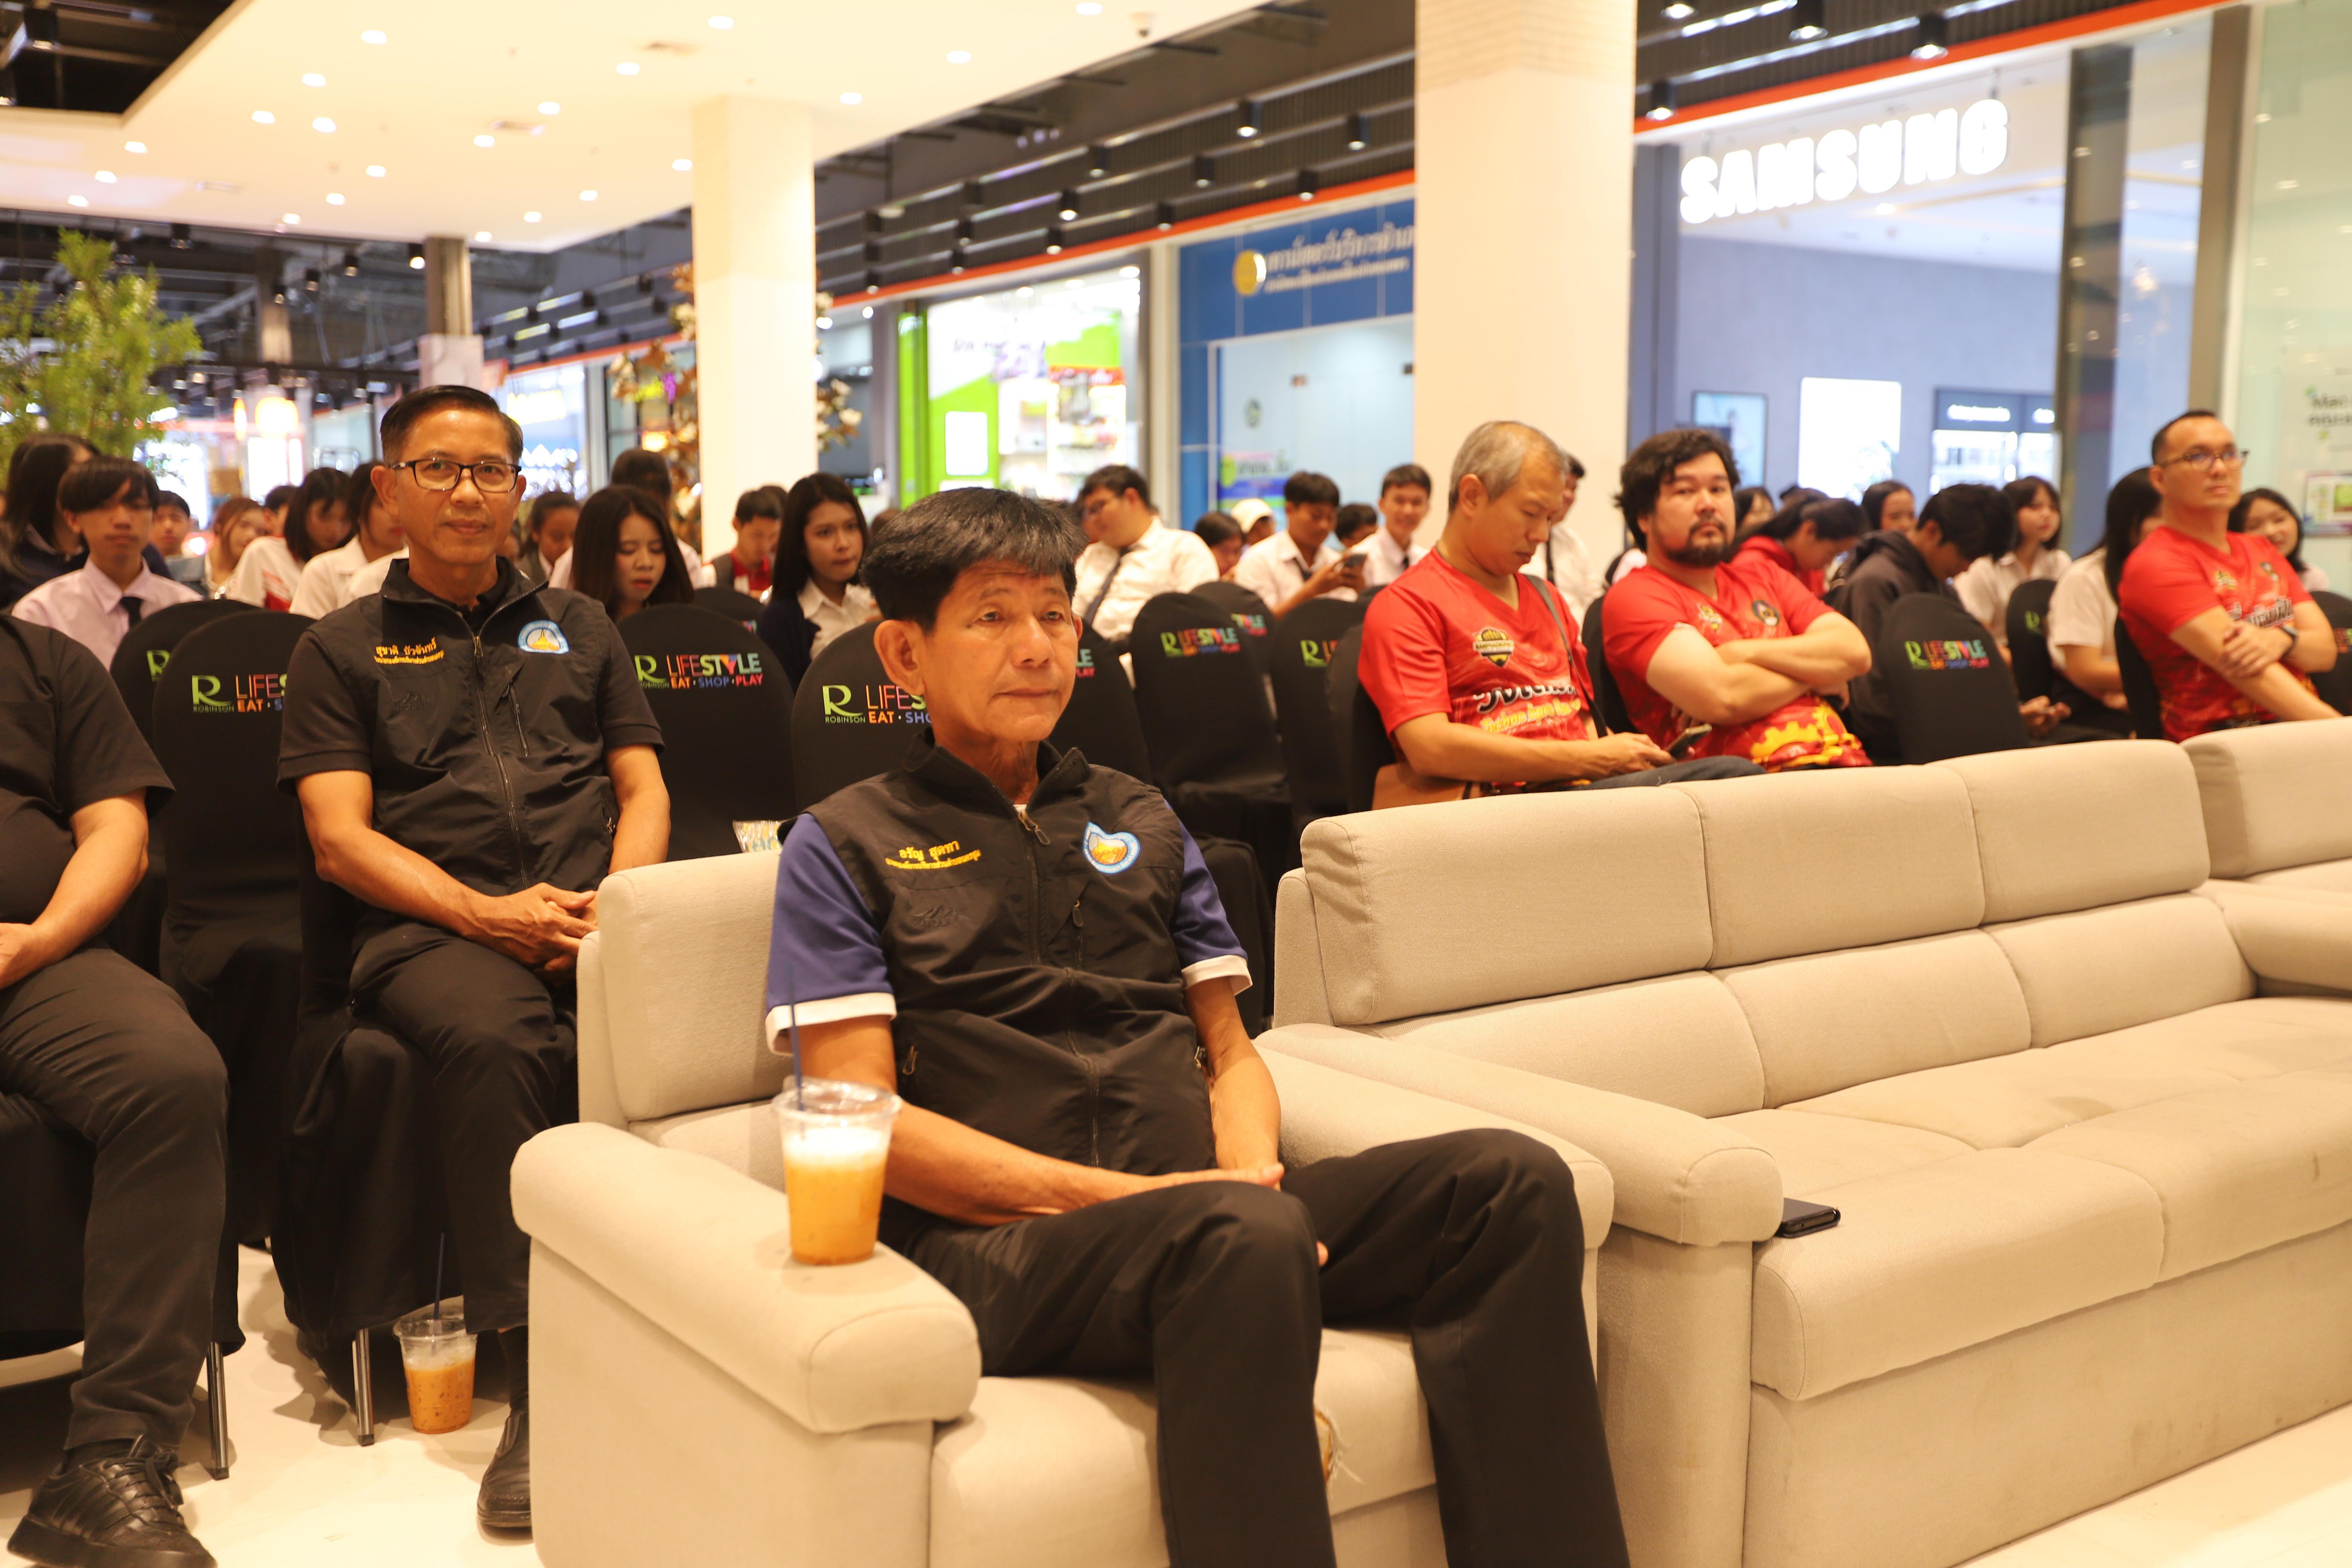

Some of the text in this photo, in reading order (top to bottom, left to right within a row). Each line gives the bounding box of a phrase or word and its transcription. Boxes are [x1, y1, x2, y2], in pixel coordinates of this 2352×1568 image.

[1680, 99, 2008, 224] SAMSUNG
[635, 652, 762, 683] R LIFESTYLE
[670, 677, 691, 689] EAT
[698, 675, 730, 688] SHOP
[735, 673, 763, 687] PLAY
[191, 675, 232, 706] R
[193, 704, 234, 713] ROBINSON
[237, 698, 263, 712] EAT
[822, 684, 864, 716] R
[868, 711, 894, 724] EAT
